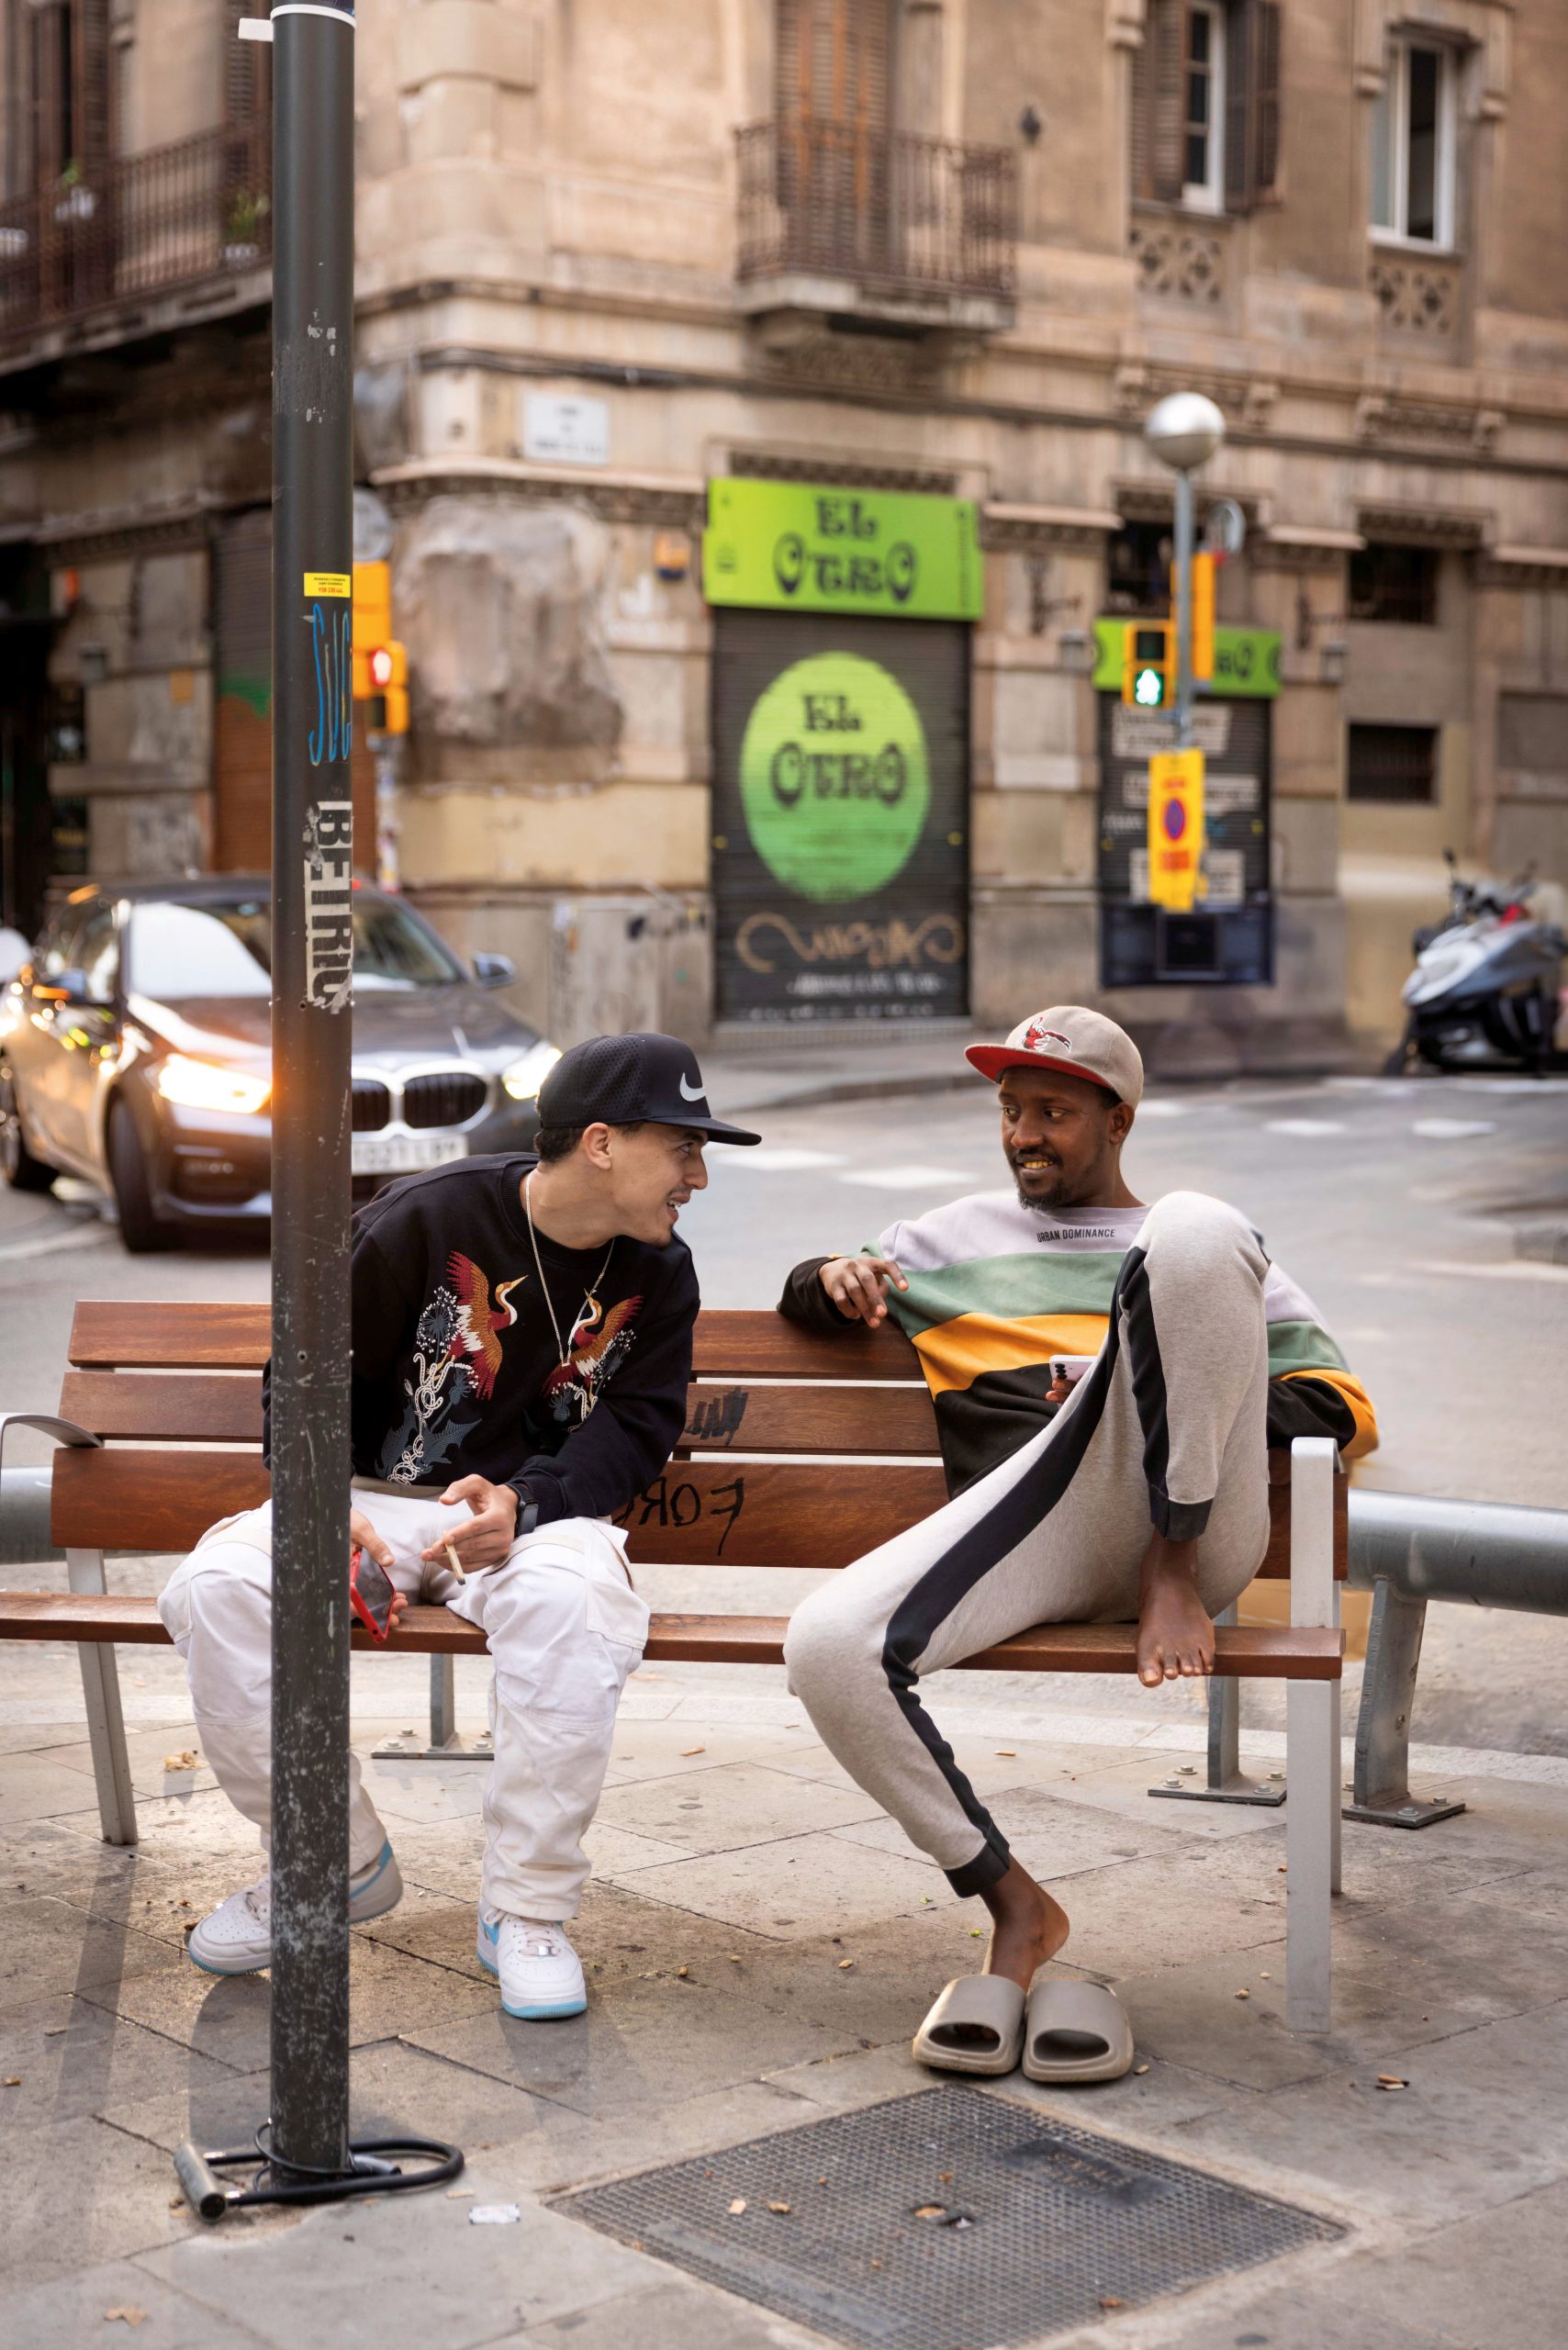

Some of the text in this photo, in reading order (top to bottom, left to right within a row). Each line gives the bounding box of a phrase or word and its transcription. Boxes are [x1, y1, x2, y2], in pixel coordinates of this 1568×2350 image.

[814, 497, 878, 537] EL
[773, 532, 915, 603] OTRO
[804, 695, 861, 732] EL
[769, 740, 906, 811] OTRO
[1036, 1228, 1116, 1243] URBAN DOMINANCE
